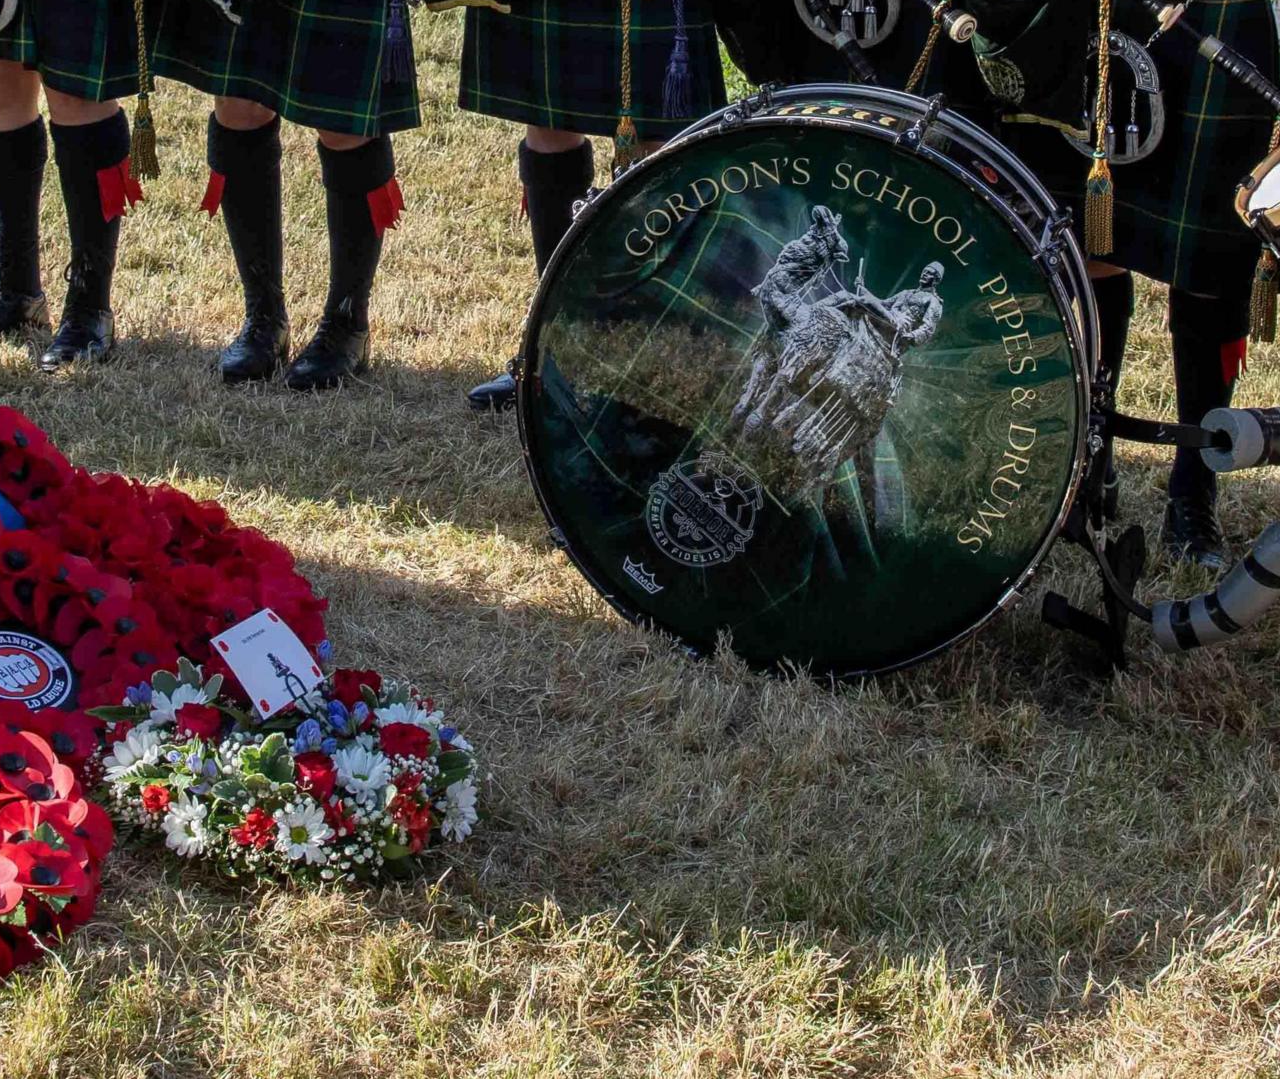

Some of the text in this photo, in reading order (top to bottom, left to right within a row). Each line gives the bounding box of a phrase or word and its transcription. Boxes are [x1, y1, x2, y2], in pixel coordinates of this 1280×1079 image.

[624, 157, 1039, 556] GORDON'S SCHOOL PIPES & DRUMS
[651, 497, 721, 563] SEMPER FIDELIS
[626, 562, 657, 592] REMO
[43, 679, 65, 705] ABUSE
